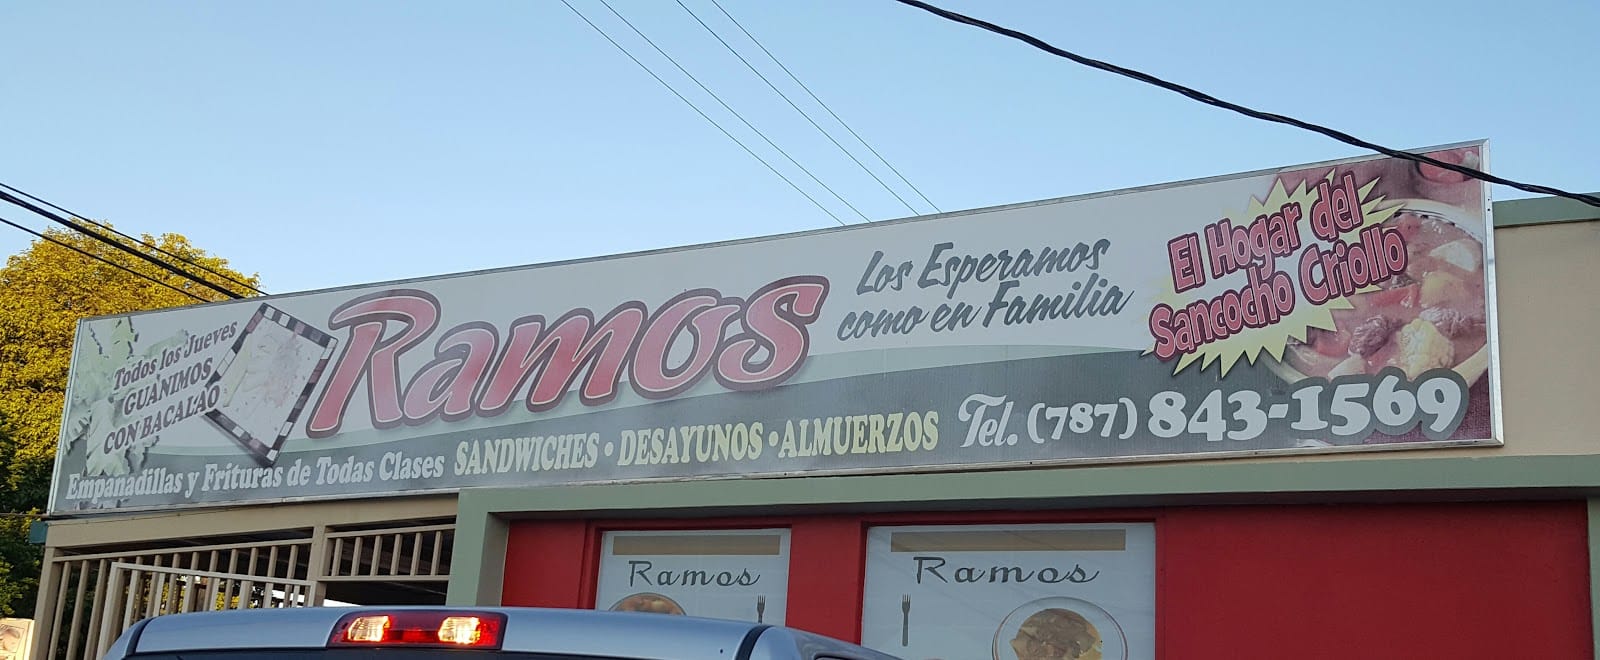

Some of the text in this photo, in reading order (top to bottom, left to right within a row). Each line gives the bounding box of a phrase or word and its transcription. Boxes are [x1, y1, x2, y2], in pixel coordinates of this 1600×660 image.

[1168, 171, 1363, 293] El Hogar del
[856, 238, 1111, 300] Los Esperamos
[1149, 224, 1408, 361] Sancocho Criollo
[836, 272, 1135, 341] como en Familia
[113, 321, 237, 391] Todos los Jueves
[123, 357, 213, 416] GUANIMOS
[306, 275, 830, 438] Ramos
[103, 421, 140, 455] CON
[956, 376, 1463, 449] Tel. (787) 843-1569
[65, 453, 445, 503] Empanadillas y Frituras de Todas Clases
[454, 432, 599, 476] SANDWICHES
[616, 421, 763, 466] DESAYUNOS
[628, 560, 760, 587] Ramos
[913, 556, 1099, 584] Ramos
